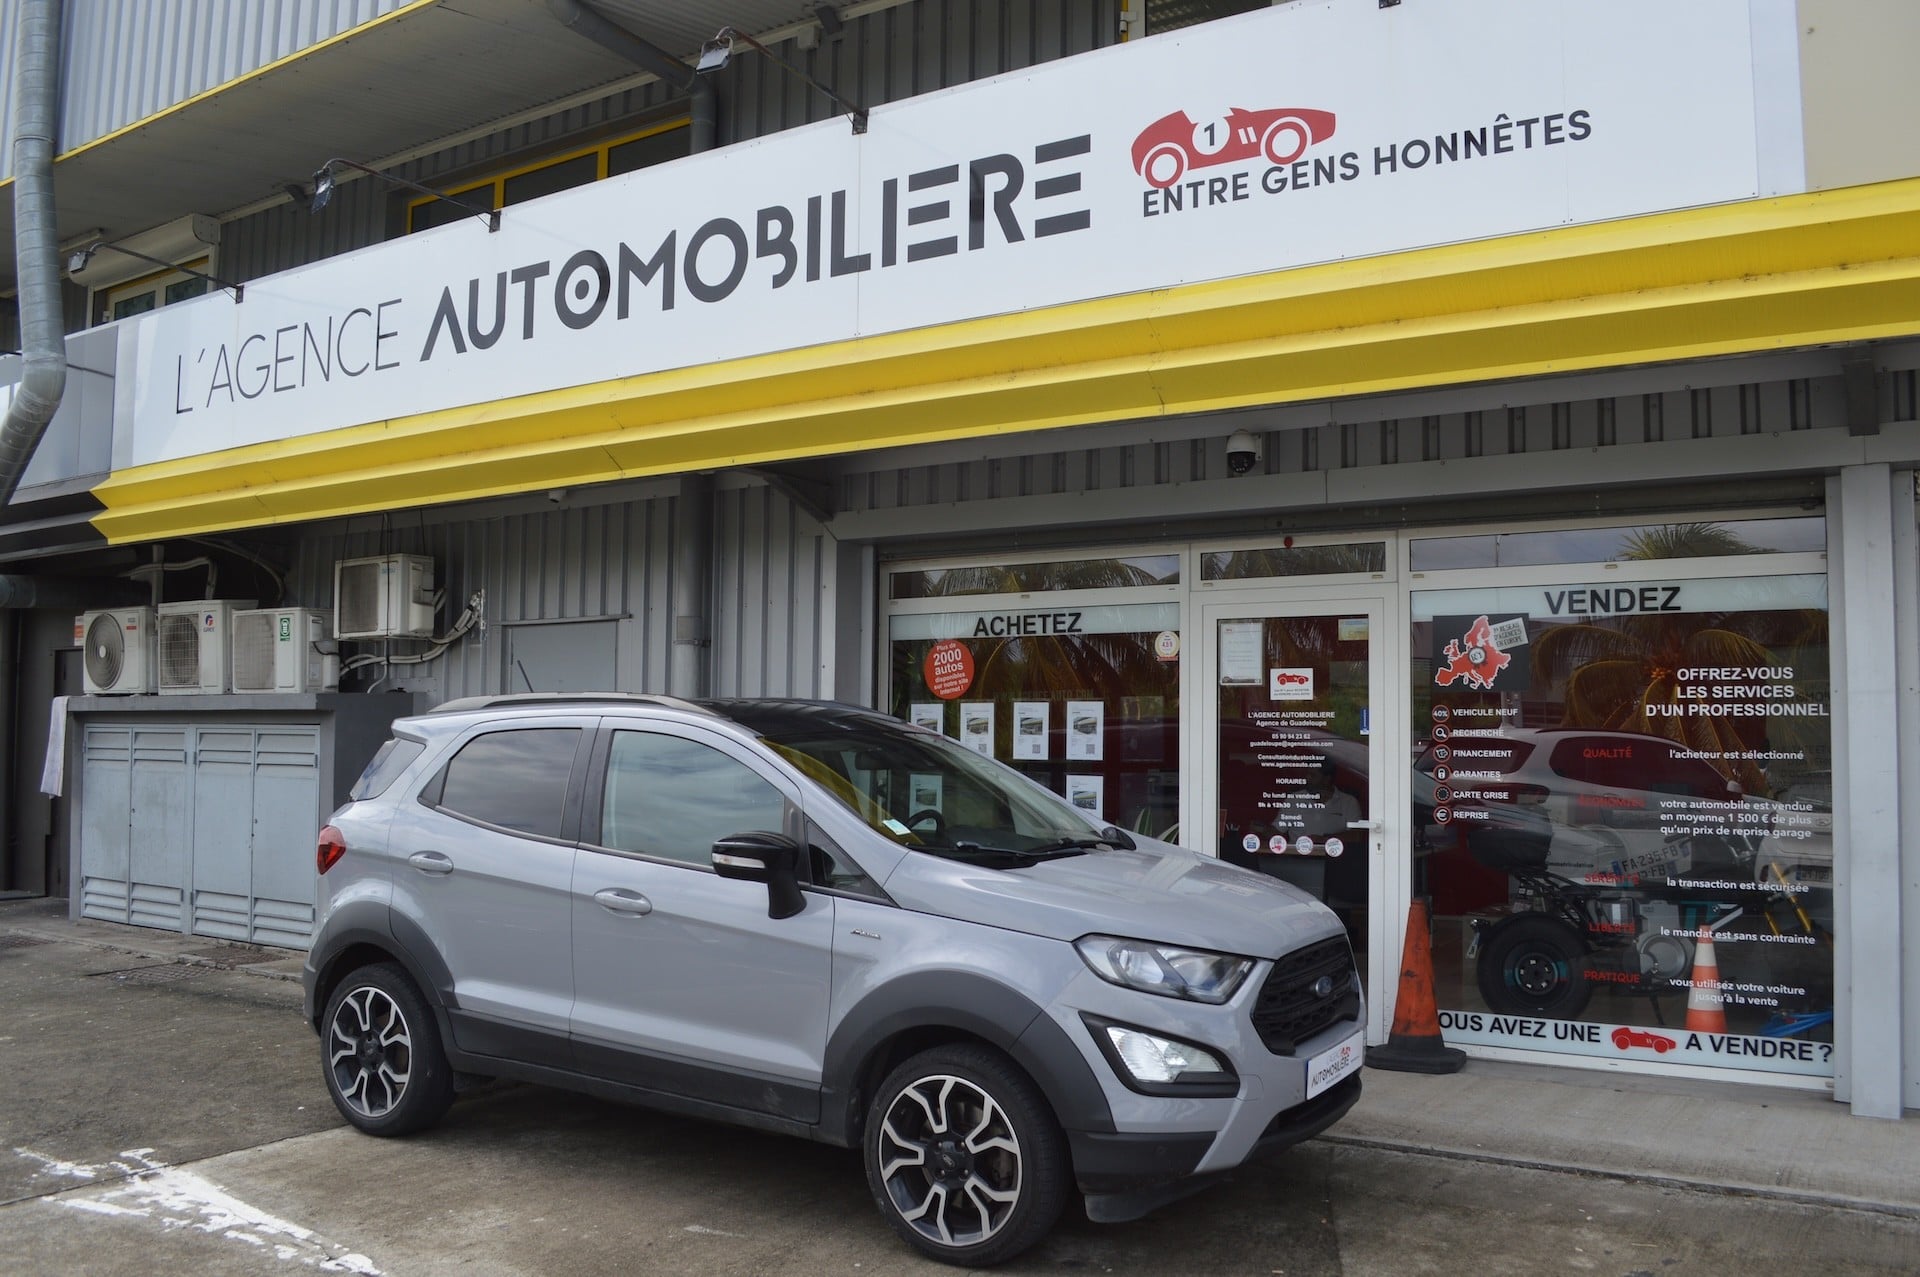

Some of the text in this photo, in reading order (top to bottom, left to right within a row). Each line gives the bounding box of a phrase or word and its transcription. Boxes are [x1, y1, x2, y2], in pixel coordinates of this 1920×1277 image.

[1204, 122, 1215, 146] 1
[1143, 109, 1592, 217] ENTRE GENS HONNÊTES
[176, 134, 1091, 414] L'AGENCE AUTOMOBILIERE
[1544, 586, 1681, 614] VENDEZ
[973, 612, 1082, 636] ACHETEZ
[933, 648, 962, 666] 2000
[935, 662, 964, 676] autos
[1677, 667, 1794, 681] OFFREZ-VOUS
[1677, 685, 1795, 699] LES SERVICES
[1452, 708, 1518, 716] VEHICULE NEUF
[1688, 703, 1830, 717] PROFESSIONNEL
[1255, 720, 1279, 728] Agence
[1289, 719, 1327, 728] Guadeloupe
[1452, 729, 1504, 737] RECHERCHE
[1583, 747, 1632, 759] QUALITÉ
[1723, 751, 1740, 760] est
[1741, 748, 1805, 760] sélectionné
[1453, 791, 1509, 799] CARTE GRISE
[1660, 800, 1814, 812] votre automobile est vendue
[1453, 811, 1489, 819] REPRISE
[1676, 815, 1725, 825] moyenne
[1727, 814, 1733, 822] 1
[1737, 814, 1759, 823] 500
[1761, 814, 1769, 823] €
[1771, 814, 1786, 824] de
[1788, 814, 1812, 826] plus
[1693, 825, 1714, 837] prix
[1716, 825, 1730, 835] de
[1732, 827, 1770, 839] reprise
[1772, 829, 1812, 840] garage
[1666, 877, 1810, 893] la transaction est sécurisée
[1660, 926, 1817, 945] le mandat est sans contrainte
[1583, 970, 1641, 984] PRATIQUE
[1669, 979, 1806, 996] vous utilisez votre voiture
[1735, 993, 1745, 1004] la
[1747, 996, 1779, 1007] vente
[1438, 1011, 1601, 1043] OUS AVEZ UNE
[1685, 1033, 1833, 1063] A VENDRE ?
